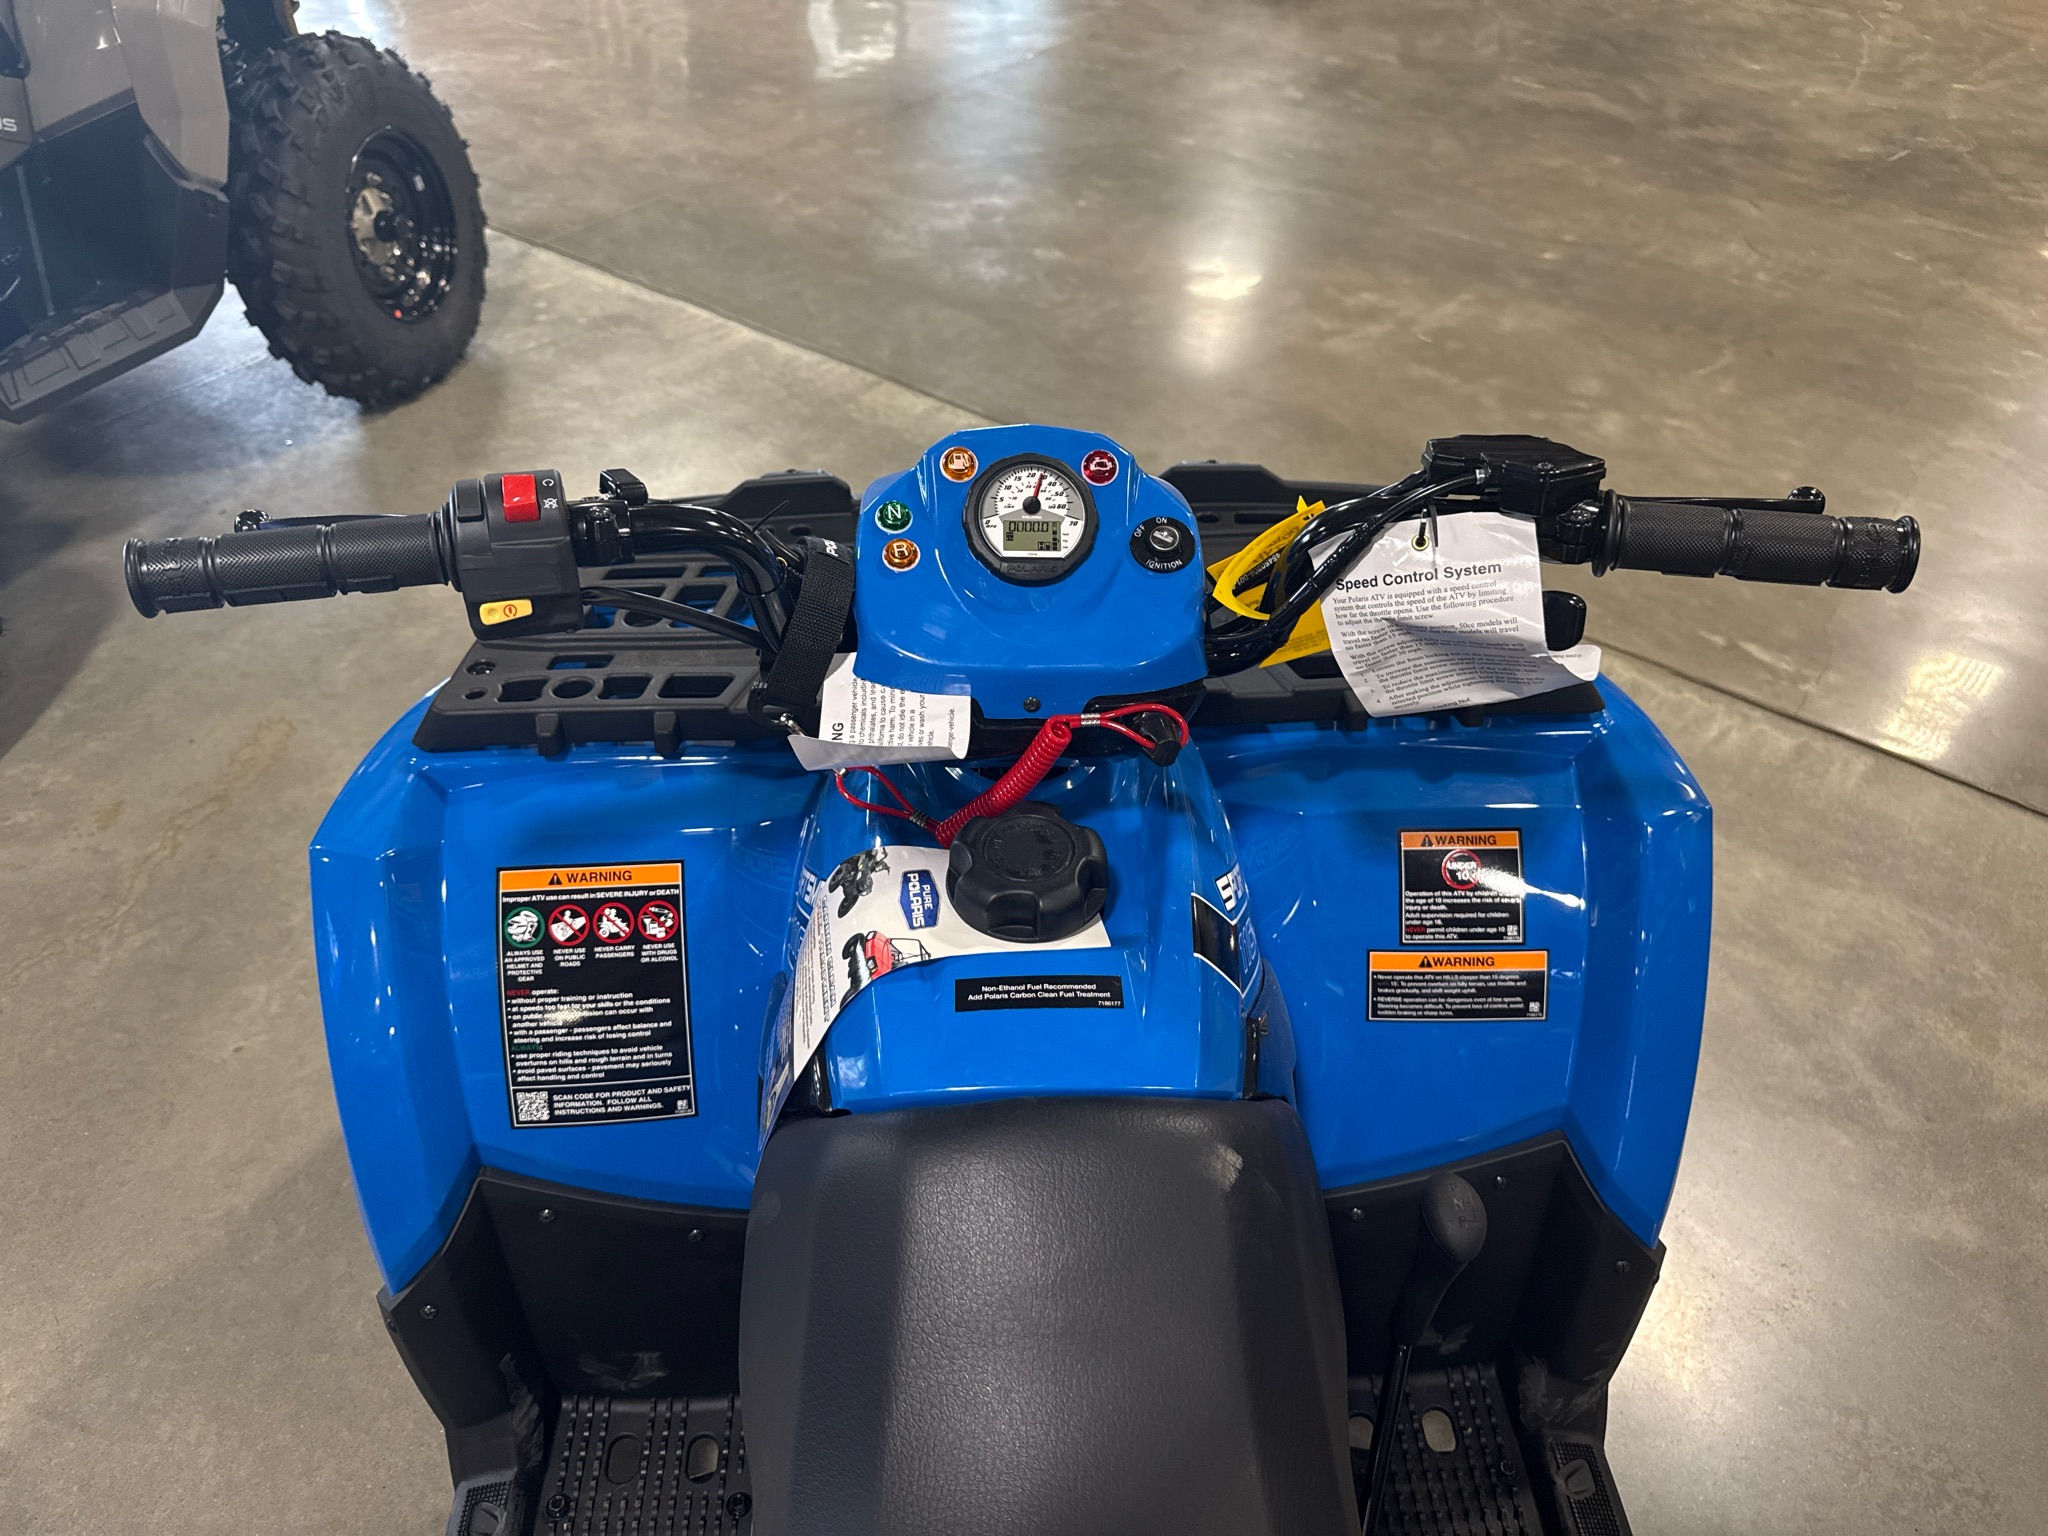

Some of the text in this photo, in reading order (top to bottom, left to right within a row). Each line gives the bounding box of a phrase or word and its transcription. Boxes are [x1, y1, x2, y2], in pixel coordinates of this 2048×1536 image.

[887, 504, 902, 518] N
[1134, 524, 1145, 537] OFF
[893, 544, 909, 559] R
[1146, 559, 1183, 569] IGNITION
[1336, 564, 1501, 592] Speed Control System
[1394, 589, 1425, 599] equipped
[1449, 584, 1470, 593] speed
[1471, 580, 1496, 589] control
[1368, 601, 1393, 609] controls
[1407, 597, 1426, 606] speed
[1449, 592, 1465, 600] ATV
[1443, 601, 1476, 609] following
[1479, 596, 1514, 606] procedure
[889, 706, 896, 714] To
[849, 702, 858, 733] passenger
[858, 708, 867, 737] chemicals
[1435, 835, 1497, 845] WARNING
[566, 870, 632, 883] WARNING
[907, 873, 925, 927] POLARIS
[922, 884, 933, 910] PURE
[1432, 957, 1495, 967] WARNING
[612, 1089, 646, 1097] PRODUCT
[664, 1084, 692, 1093] SAFETY
[554, 1107, 606, 1115] INSTRUCTIONS
[624, 1102, 663, 1111] WARNINGS.
